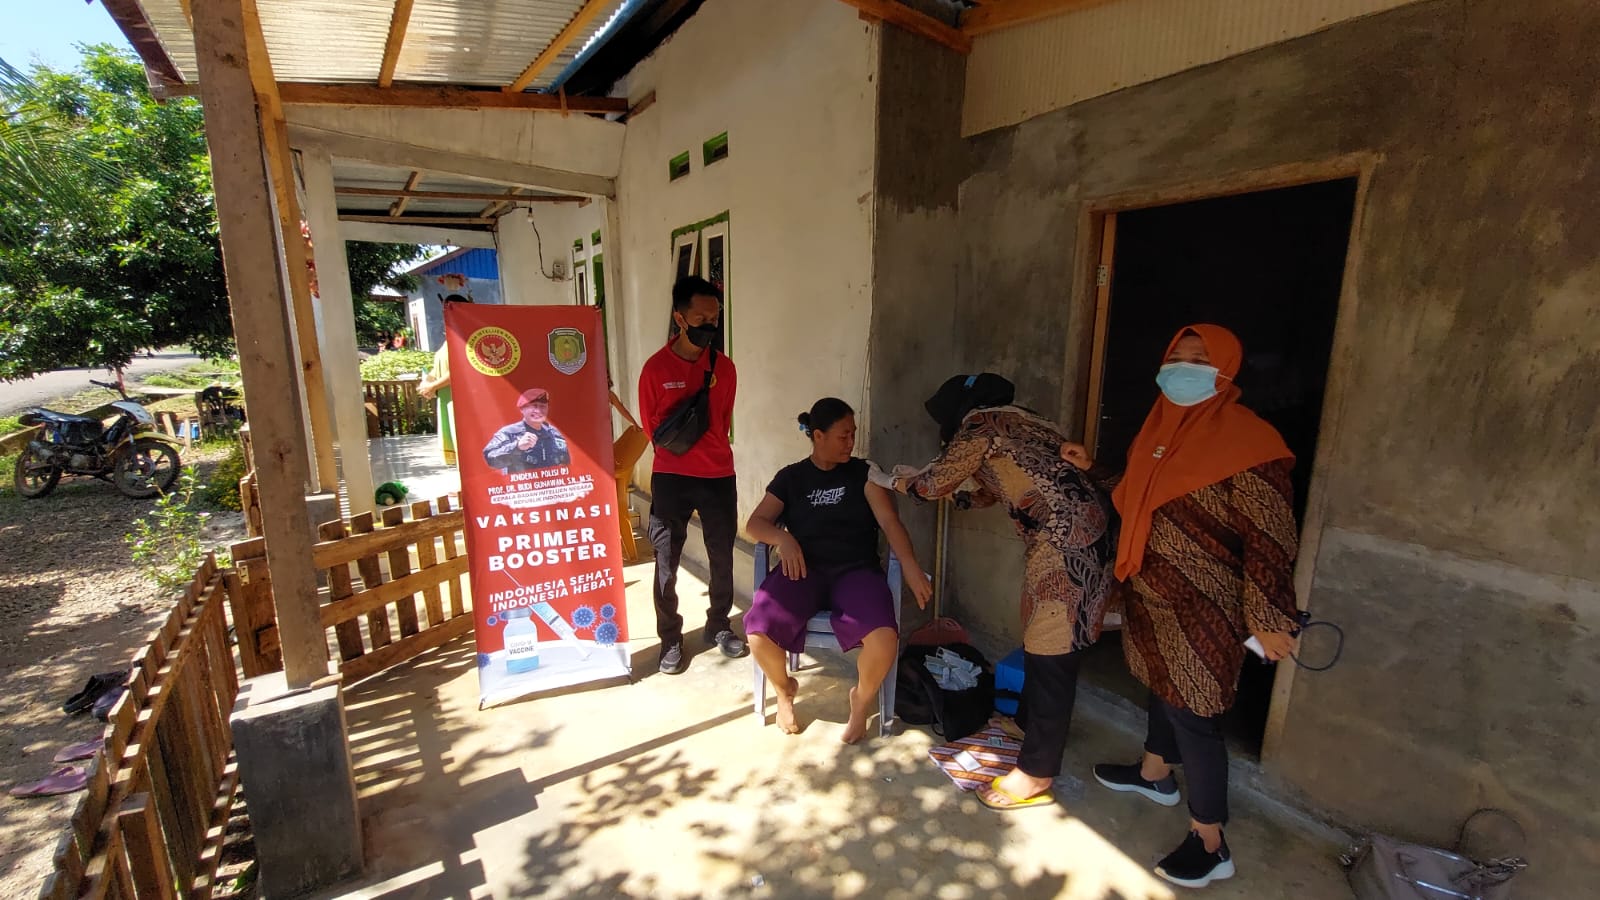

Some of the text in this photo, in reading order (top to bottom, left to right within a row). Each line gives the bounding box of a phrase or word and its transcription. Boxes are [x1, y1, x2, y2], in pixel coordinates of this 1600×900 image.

[541, 469, 559, 478] POLISI
[517, 483, 533, 492] BUDI
[476, 504, 611, 529] VAKSINASI
[498, 527, 596, 553] PRIMER
[488, 543, 607, 572] BOOSTER
[489, 568, 611, 604] INDONESIA SEHAT
[492, 577, 615, 612] INDONESIA HEBAT
[508, 645, 535, 655] VACCINE
